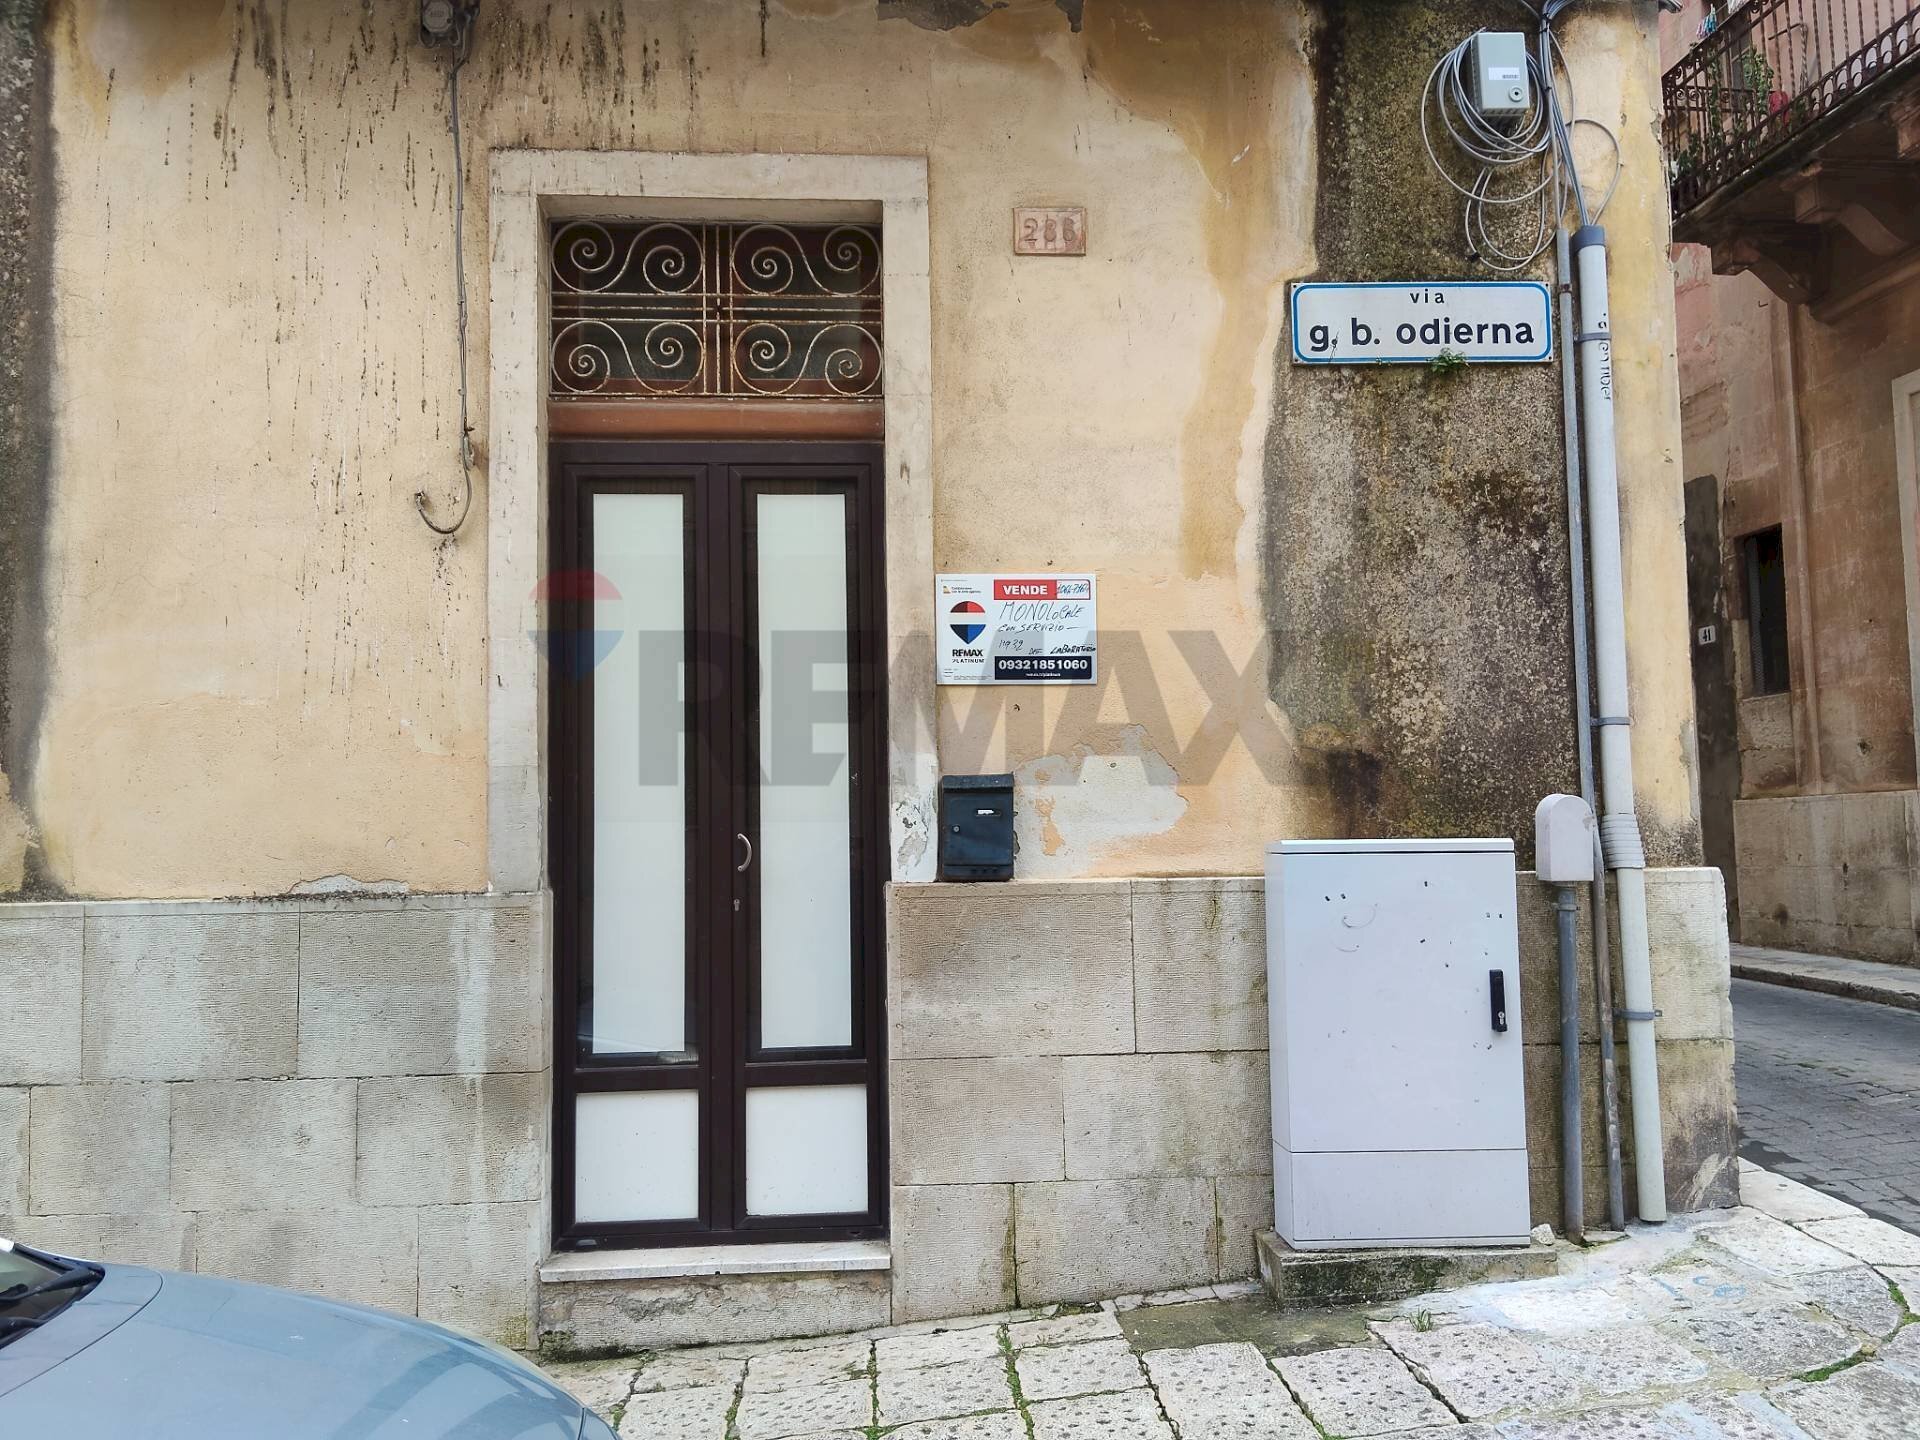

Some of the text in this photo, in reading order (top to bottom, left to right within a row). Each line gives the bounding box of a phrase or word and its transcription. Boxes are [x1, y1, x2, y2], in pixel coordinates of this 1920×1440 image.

[1410, 289, 1445, 304] via
[1351, 317, 1381, 346] b.
[1396, 316, 1534, 345] odierna
[1003, 585, 1048, 595] VENDE
[952, 649, 983, 657] REMAX
[998, 659, 1088, 670] 09321851060
